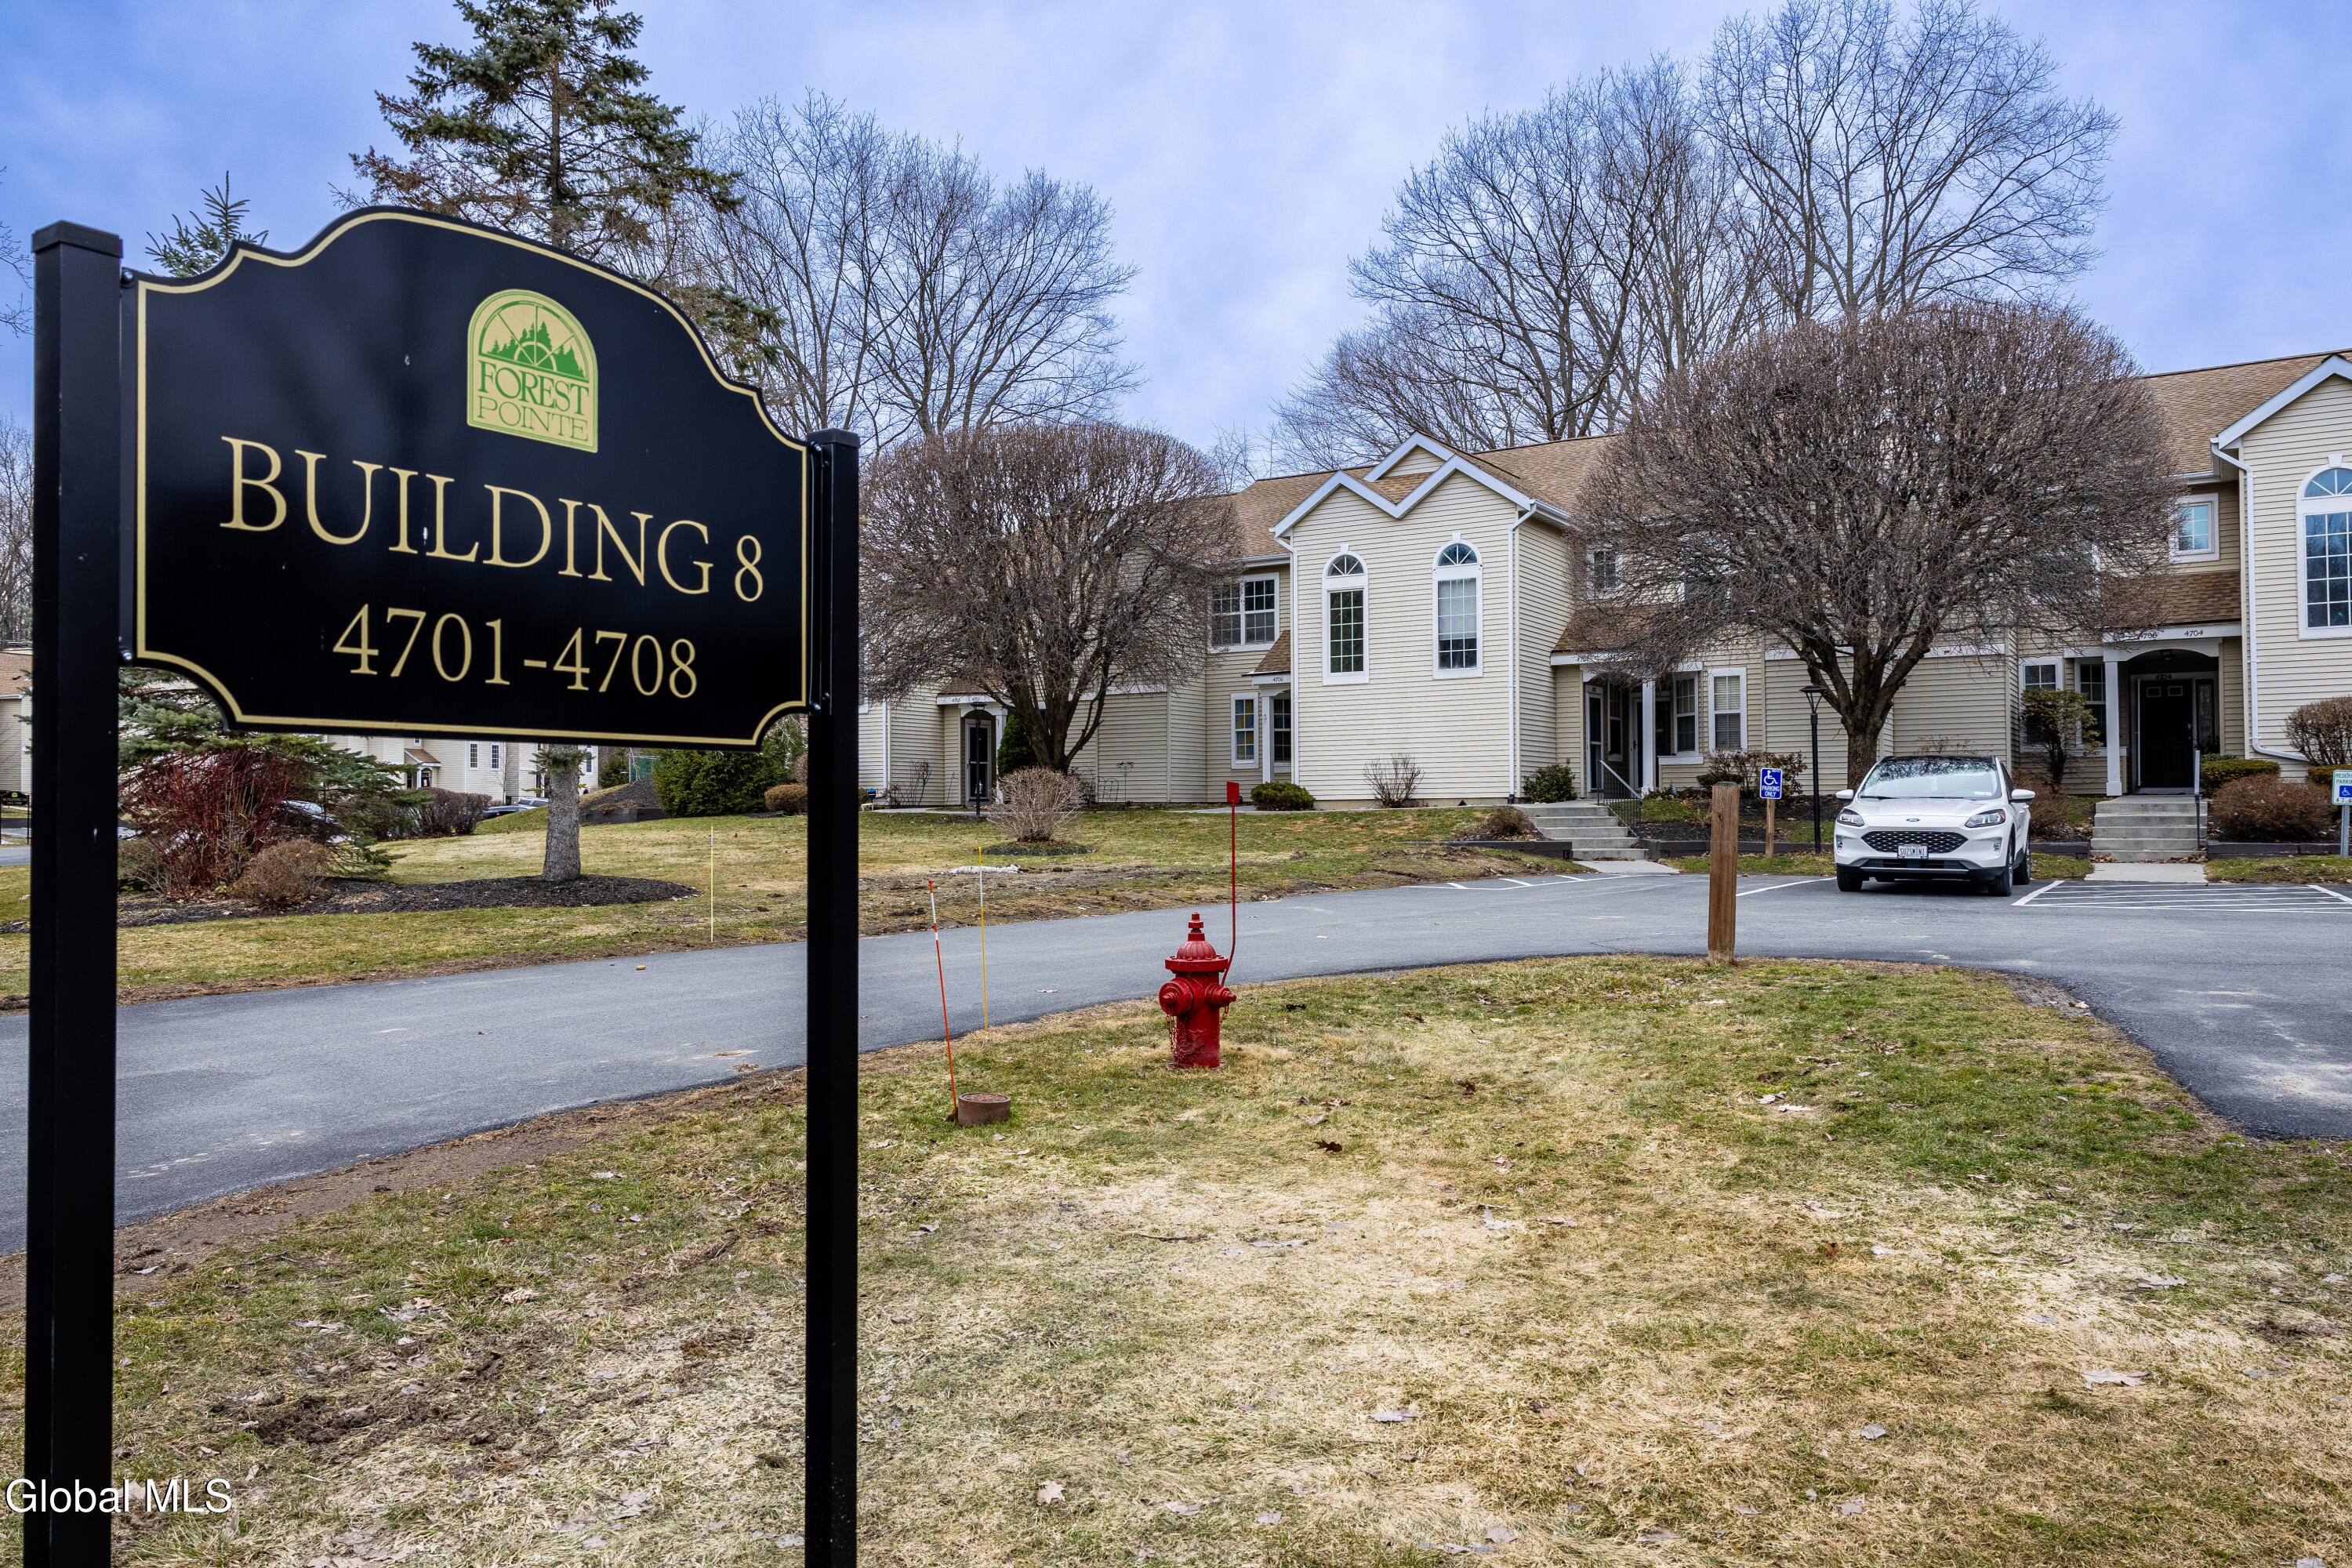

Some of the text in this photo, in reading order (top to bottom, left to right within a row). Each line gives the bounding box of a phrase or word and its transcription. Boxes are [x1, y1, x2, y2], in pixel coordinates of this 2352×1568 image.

[477, 360, 590, 416] FOREST
[477, 395, 588, 441] POINTE
[220, 437, 763, 602] BUILDING 8
[333, 604, 697, 699] 4701-4708
